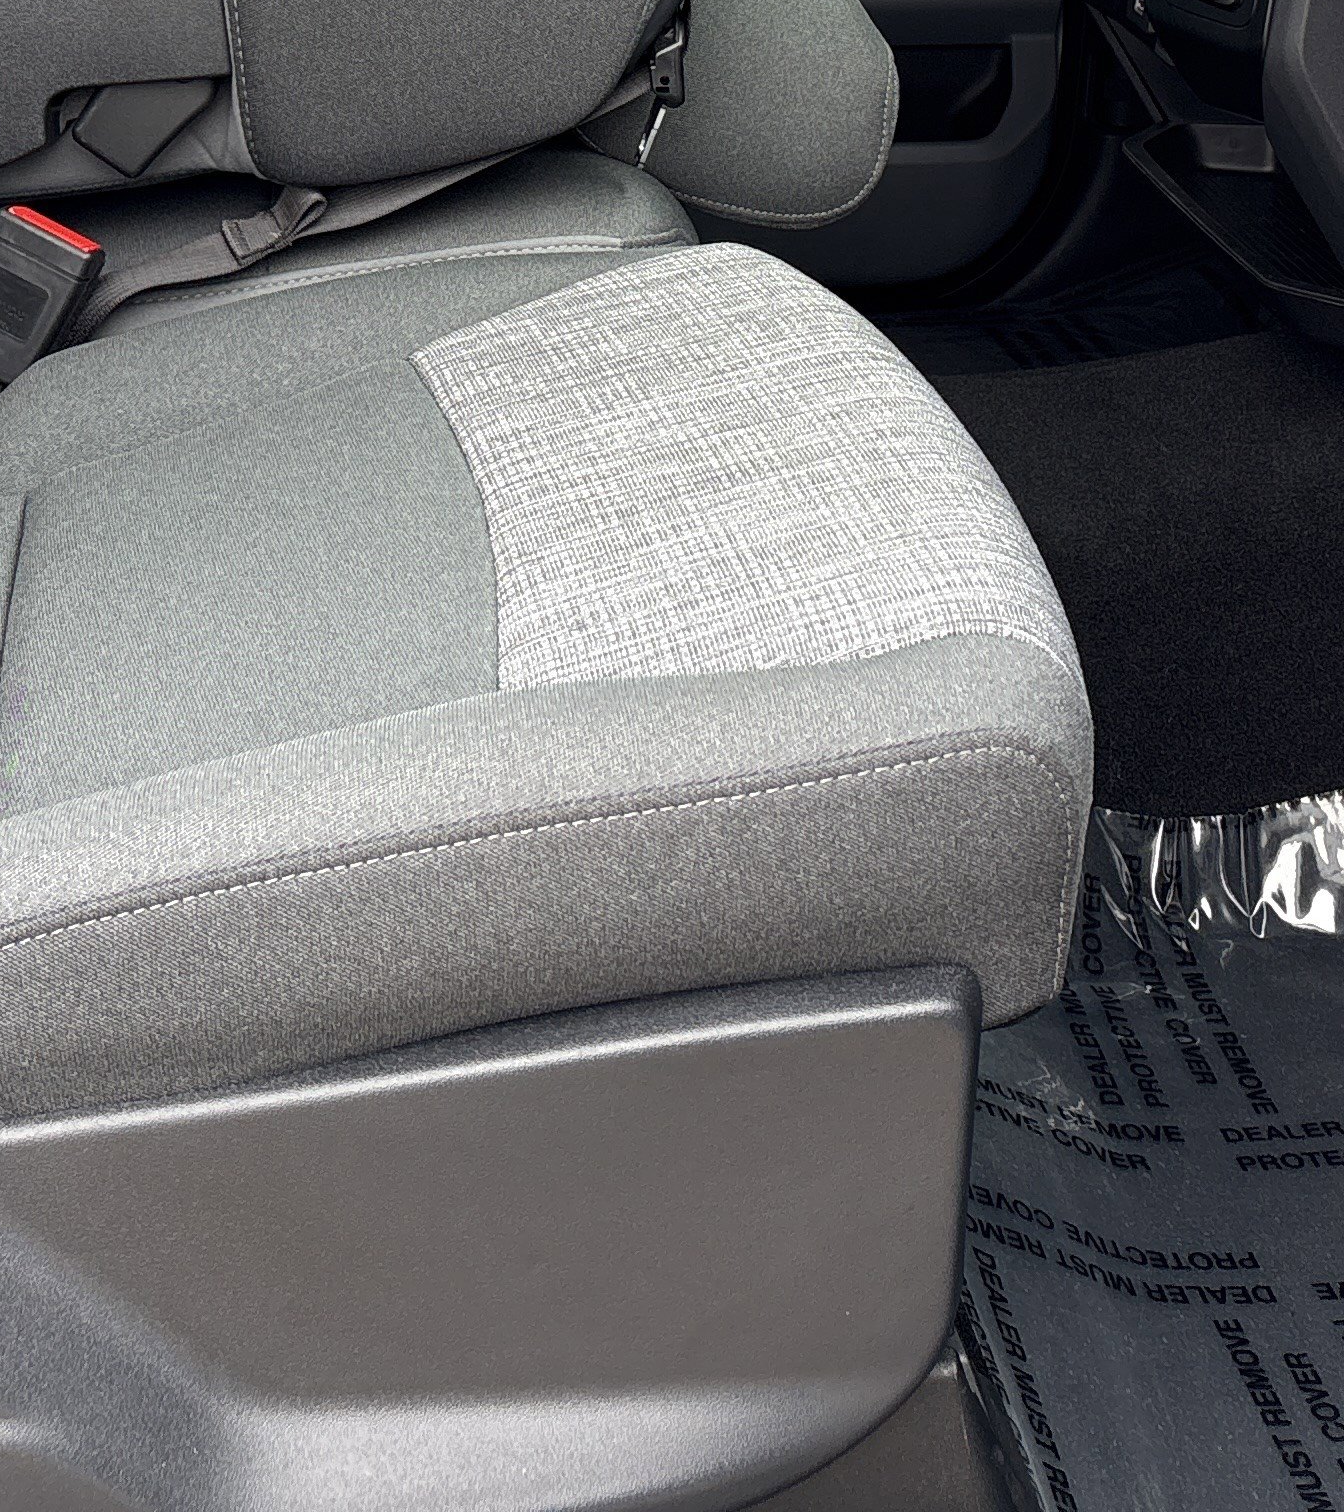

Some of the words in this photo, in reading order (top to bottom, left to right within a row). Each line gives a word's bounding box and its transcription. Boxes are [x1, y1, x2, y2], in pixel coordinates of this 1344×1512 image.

[1081, 873, 1104, 976] COVER
[1068, 1020, 1125, 1108] DEALER
[1090, 984, 1170, 1109] PROTECTIVE
[1166, 1019, 1219, 1087] COVER
[1181, 971, 1231, 1029] MUST
[1212, 1029, 1279, 1117] REMOVE
[1051, 1127, 1152, 1172] COVER
[968, 1183, 1055, 1231] COVE
[1061, 1219, 1261, 1273] PROTECTIVE
[1055, 1247, 1140, 1297] MUST
[1144, 1274, 1278, 1307] DEALER
[972, 1245, 1028, 1363] DEALER
[1011, 1362, 1062, 1462] MUST
[1212, 1317, 1293, 1428] REMOVE
